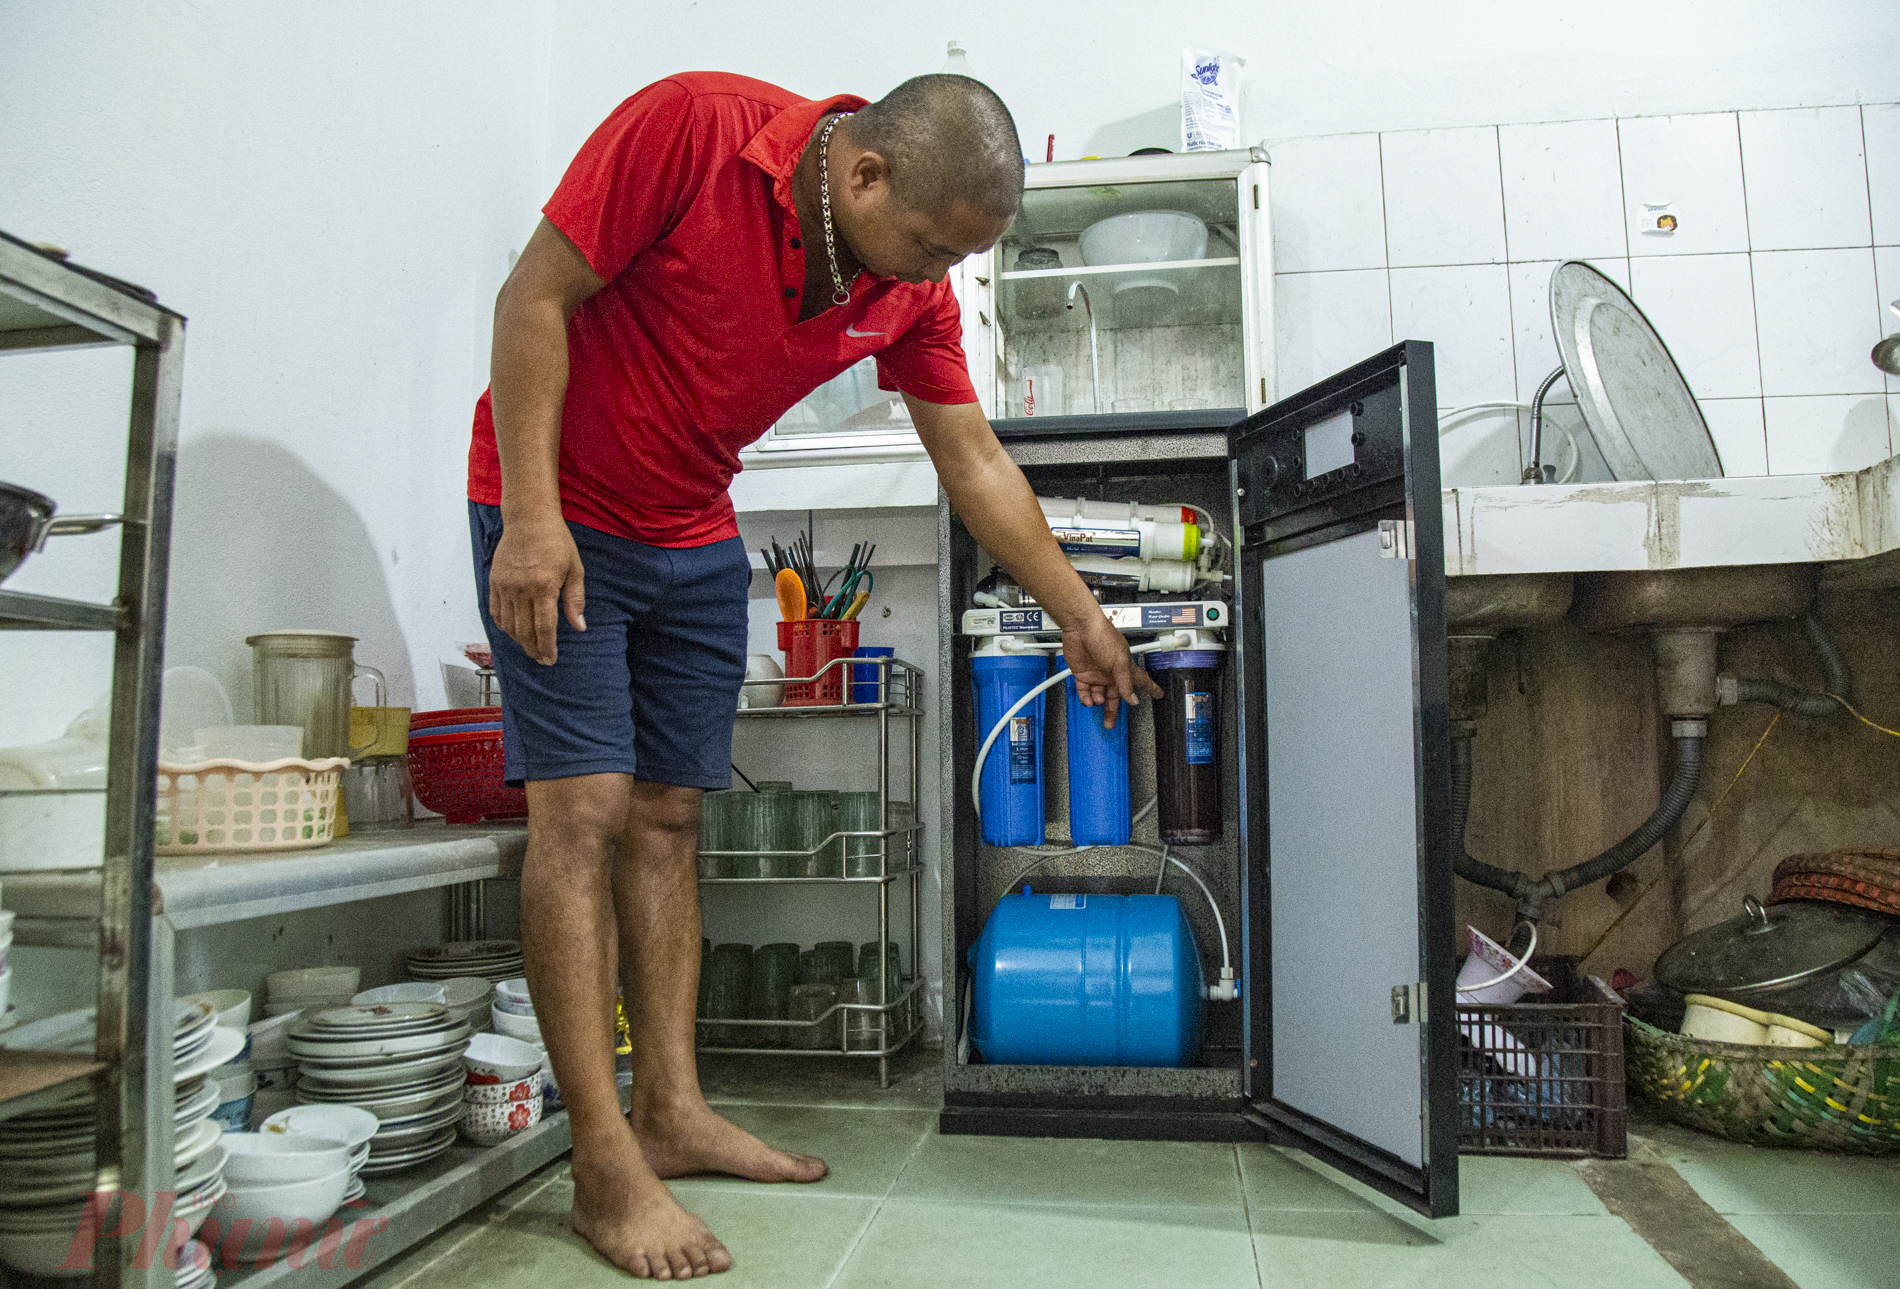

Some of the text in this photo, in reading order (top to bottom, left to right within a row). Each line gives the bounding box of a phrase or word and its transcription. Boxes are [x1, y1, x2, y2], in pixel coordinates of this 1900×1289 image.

[1196, 63, 1219, 76] Sunlight
[1063, 532, 1093, 543] VinaPat
[1026, 611, 1039, 622] CE
